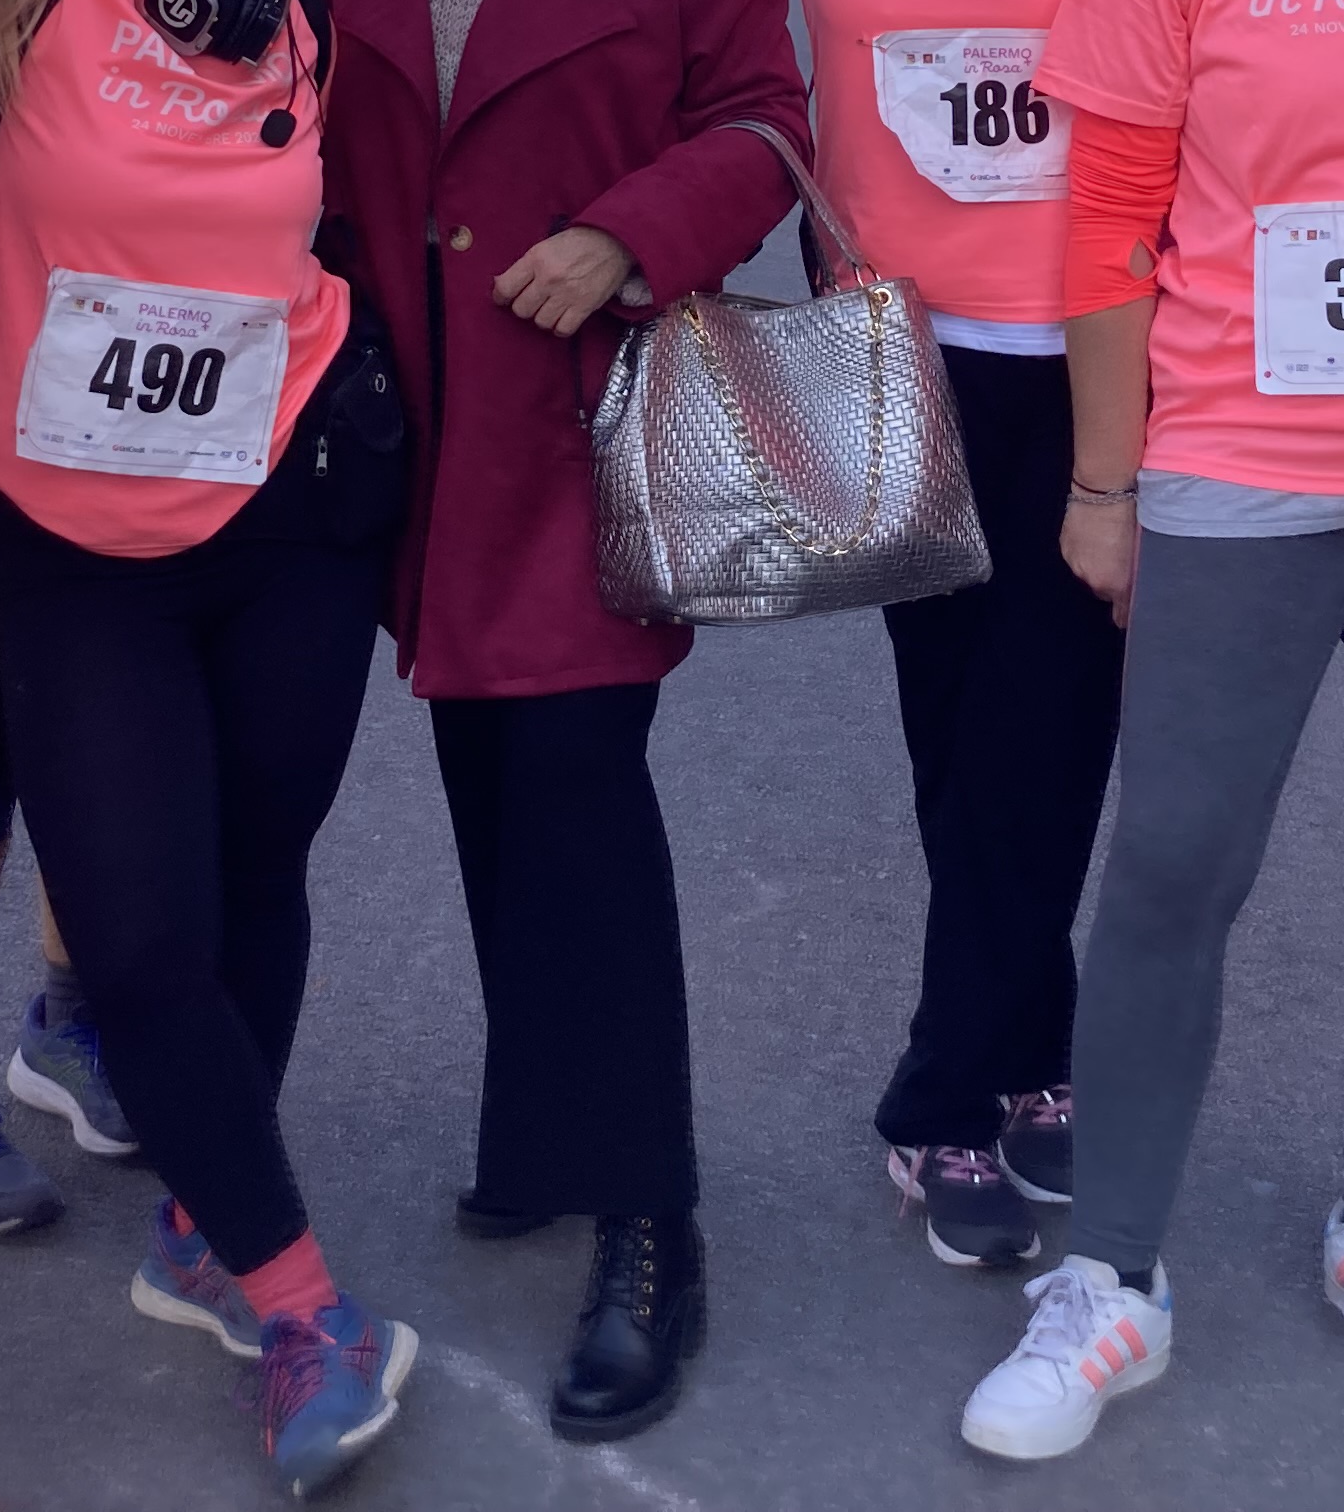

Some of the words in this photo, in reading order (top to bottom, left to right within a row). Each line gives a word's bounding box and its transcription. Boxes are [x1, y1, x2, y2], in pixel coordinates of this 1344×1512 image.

[1289, 23, 1308, 37] 24
[962, 47, 1033, 64] PALERMO
[963, 60, 978, 74] in
[980, 60, 1023, 73] Rosa
[99, 66, 151, 109] in
[939, 79, 1050, 147] 186
[131, 118, 150, 130] 24
[138, 302, 212, 327] PALERMO
[135, 318, 153, 332] in
[154, 321, 199, 338] Rosa
[88, 336, 227, 417] 490
